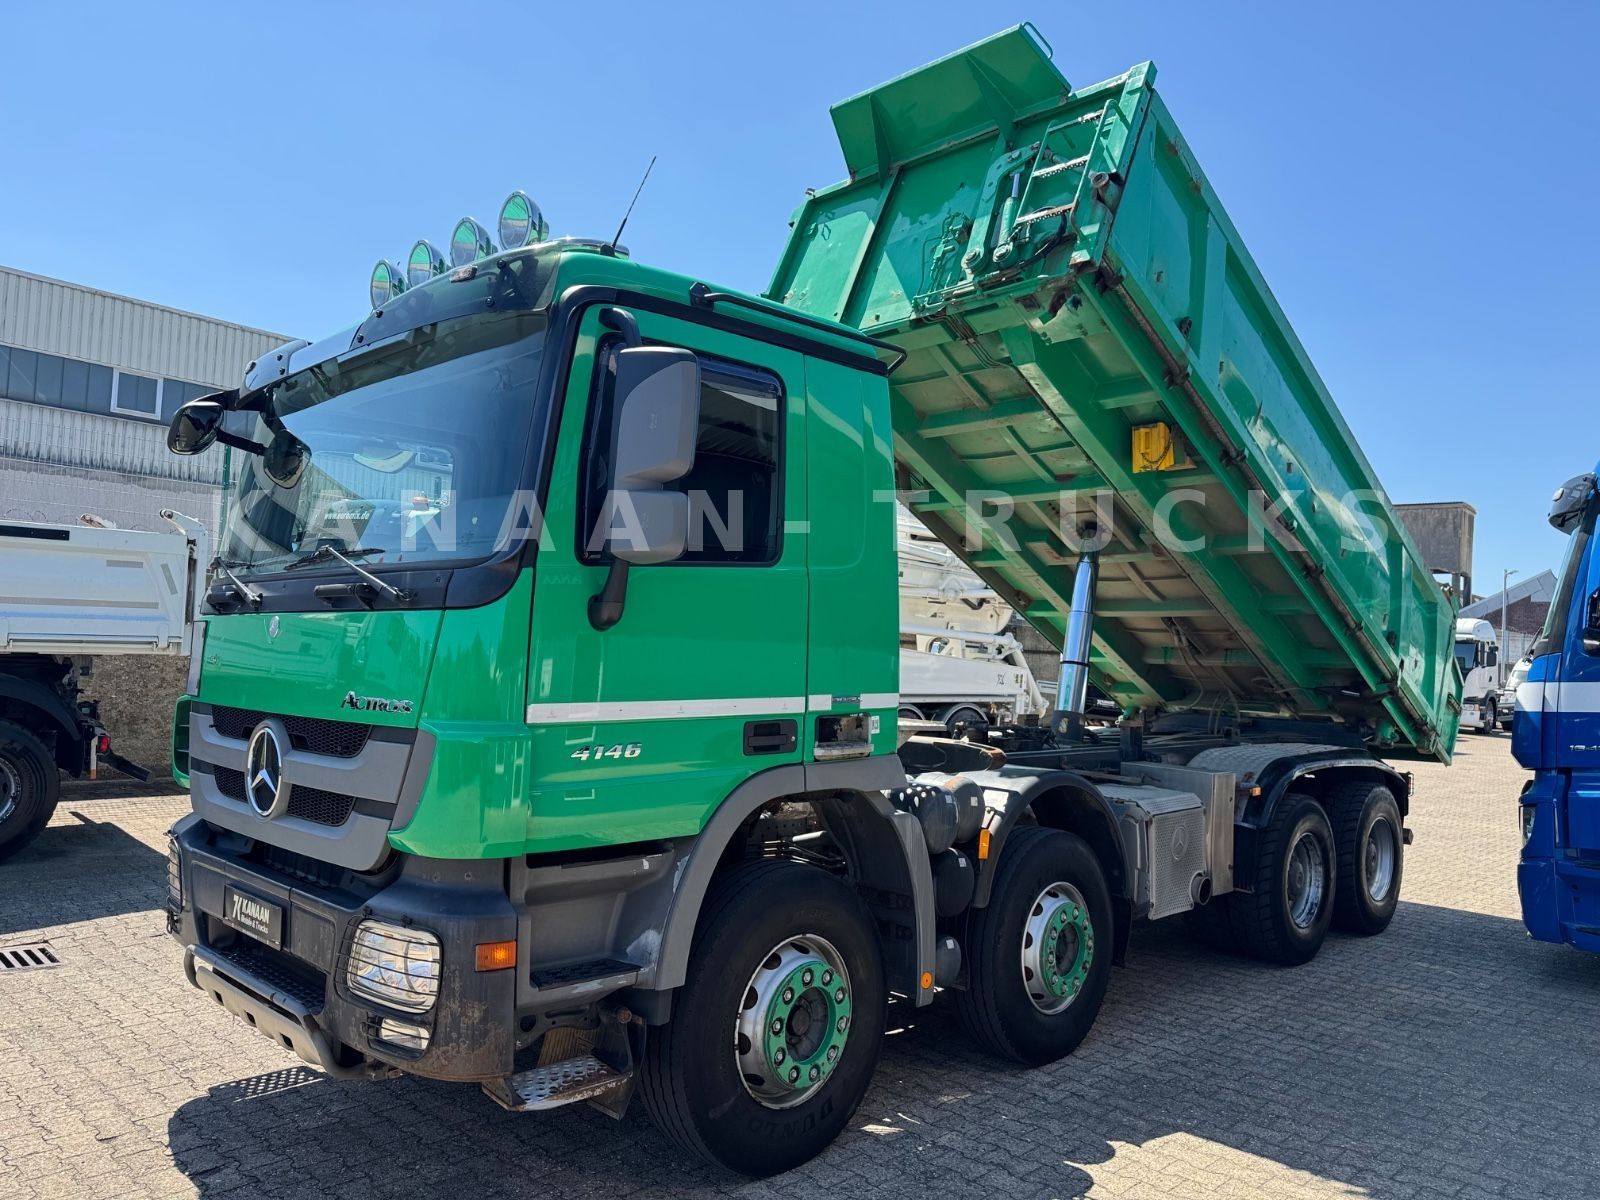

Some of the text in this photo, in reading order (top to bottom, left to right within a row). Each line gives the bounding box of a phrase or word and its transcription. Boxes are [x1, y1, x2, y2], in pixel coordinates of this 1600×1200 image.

[570, 742, 642, 761] 4146
[242, 898, 270, 924] KANAAN
[736, 1095, 834, 1138] DUNLO
